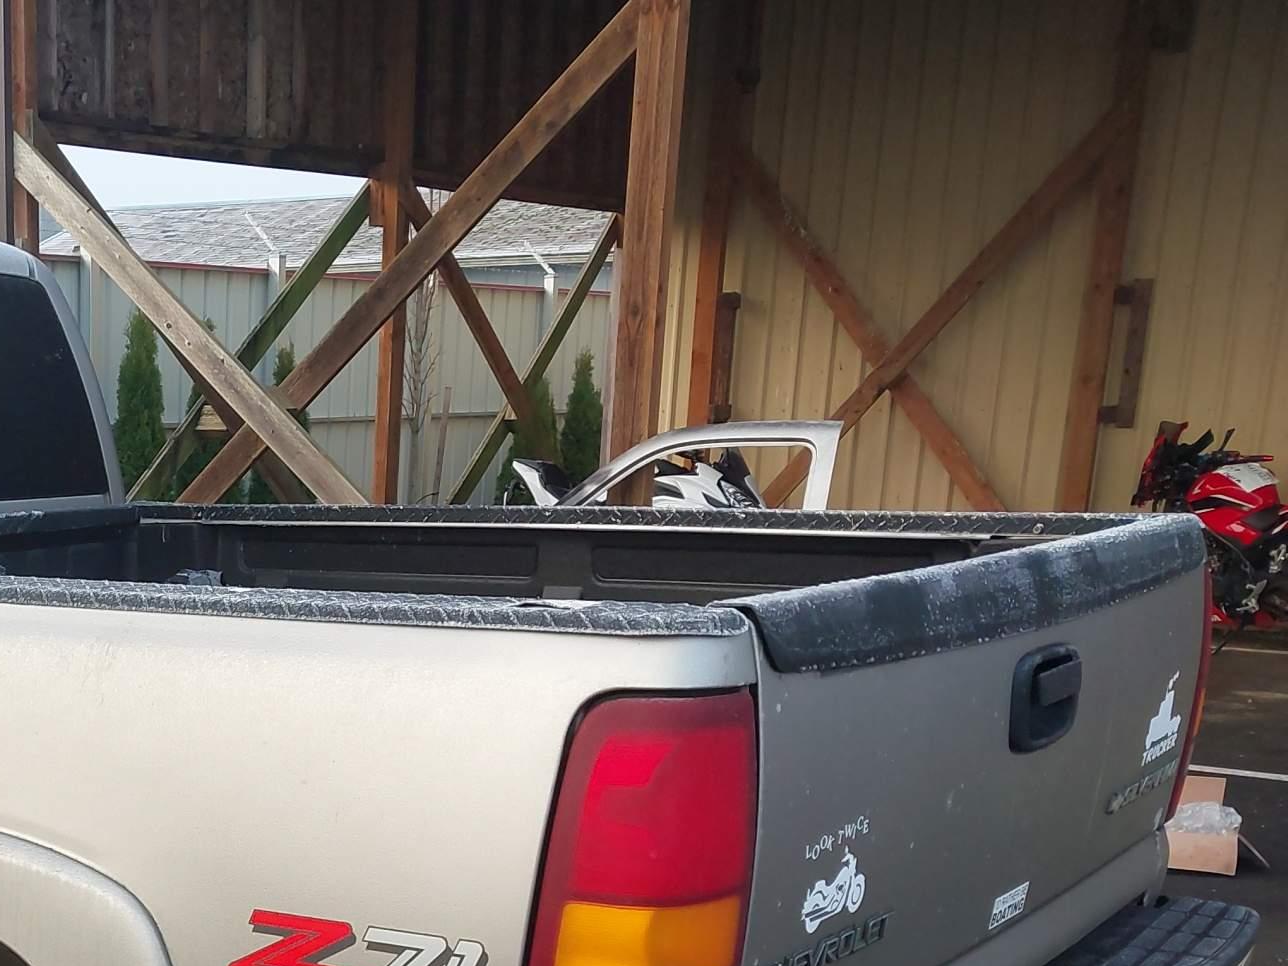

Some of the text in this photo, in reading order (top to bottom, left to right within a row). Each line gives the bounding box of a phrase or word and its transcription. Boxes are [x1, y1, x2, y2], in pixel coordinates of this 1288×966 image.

[1141, 733, 1178, 767] TRUCKER
[805, 815, 870, 860] LOOK TWICE
[991, 897, 1025, 927] BOATING
